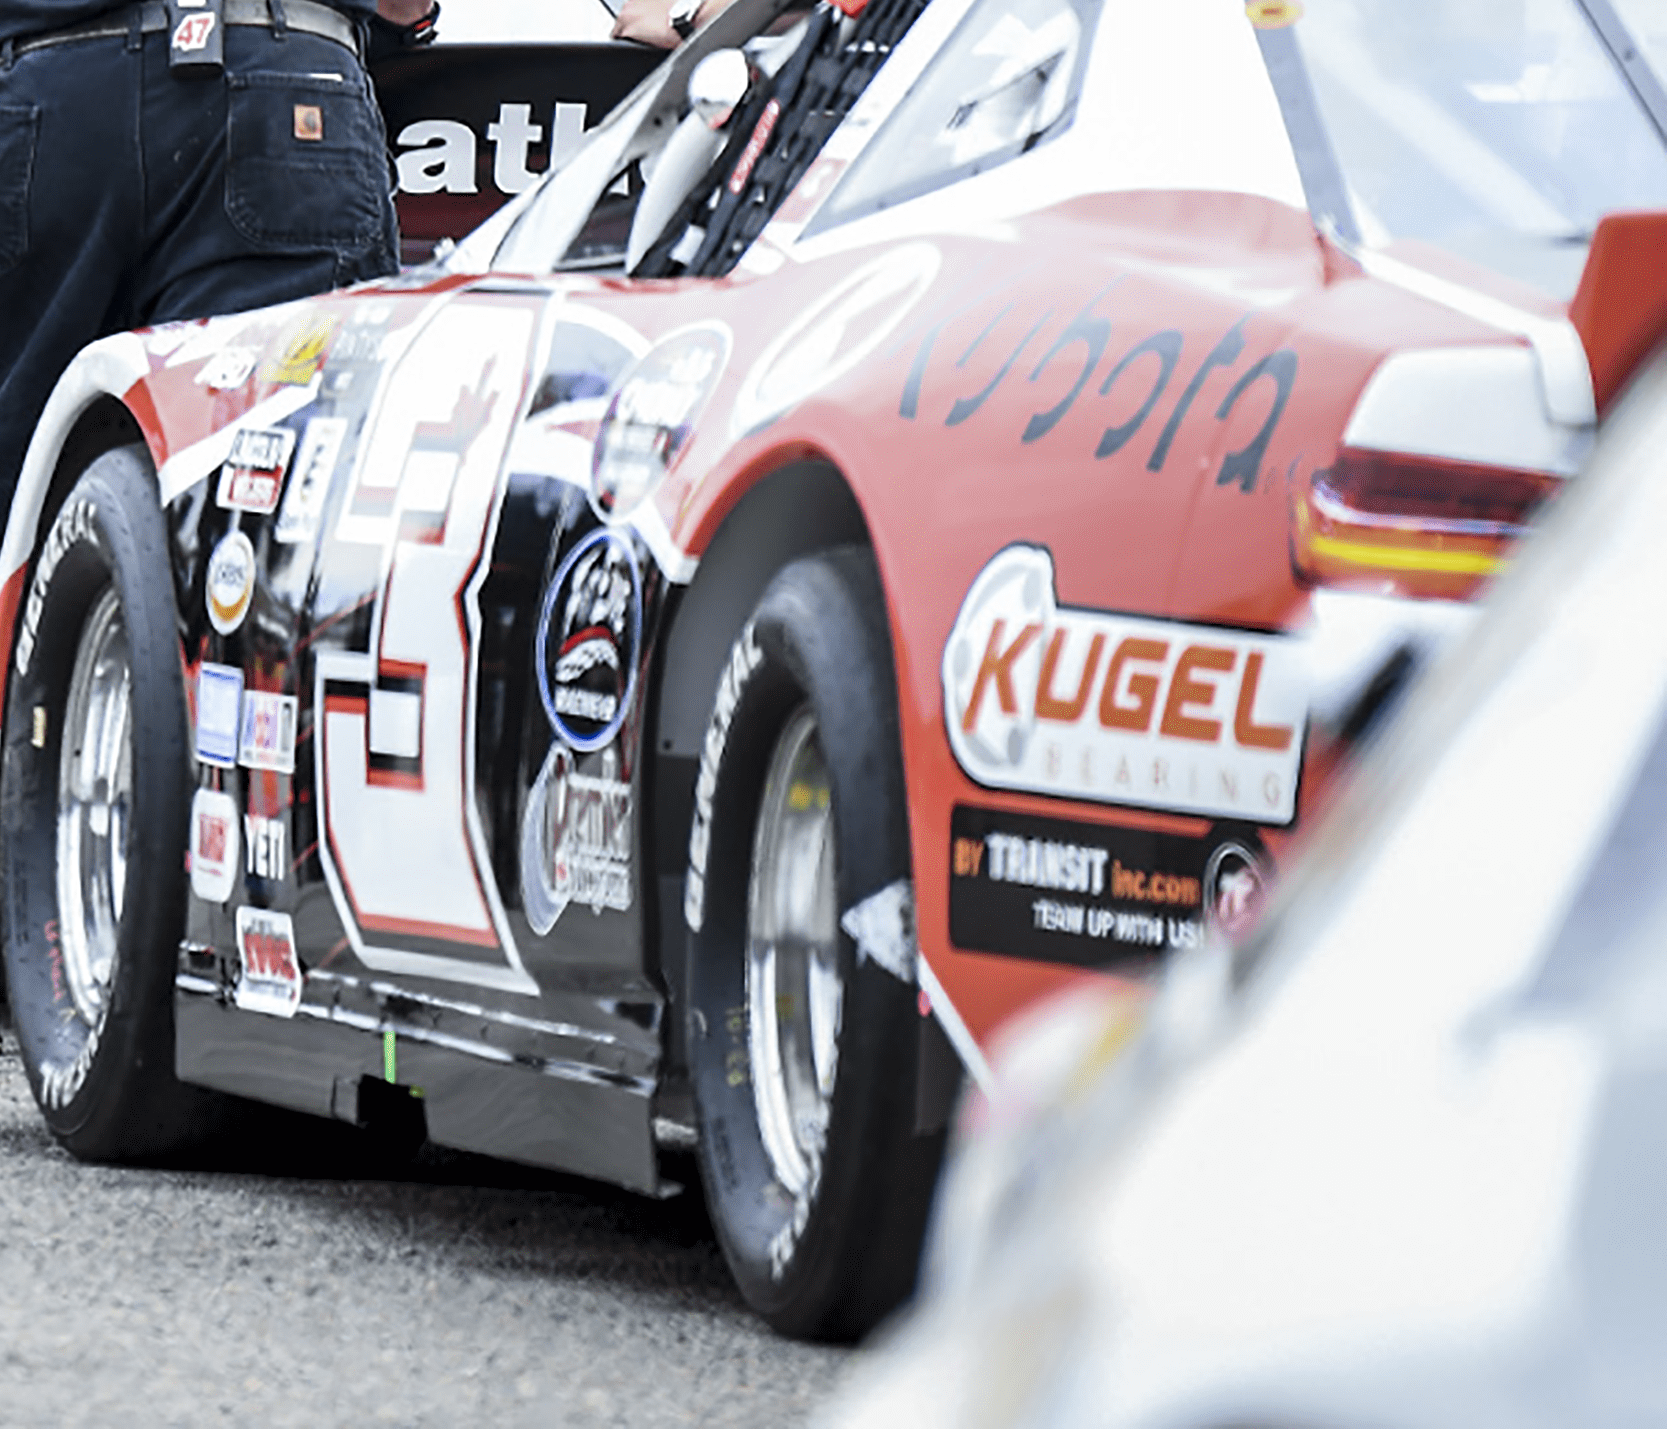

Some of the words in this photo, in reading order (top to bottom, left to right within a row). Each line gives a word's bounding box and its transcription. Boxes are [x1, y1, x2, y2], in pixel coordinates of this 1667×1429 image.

[177, 18, 210, 45] 47
[961, 617, 1295, 752] KUGEL
[1045, 744, 1284, 810] BEARING
[954, 837, 984, 877] BY
[986, 832, 1109, 896] TRANSIT
[1087, 908, 1114, 938] UP
[1114, 910, 1164, 946] WITH
